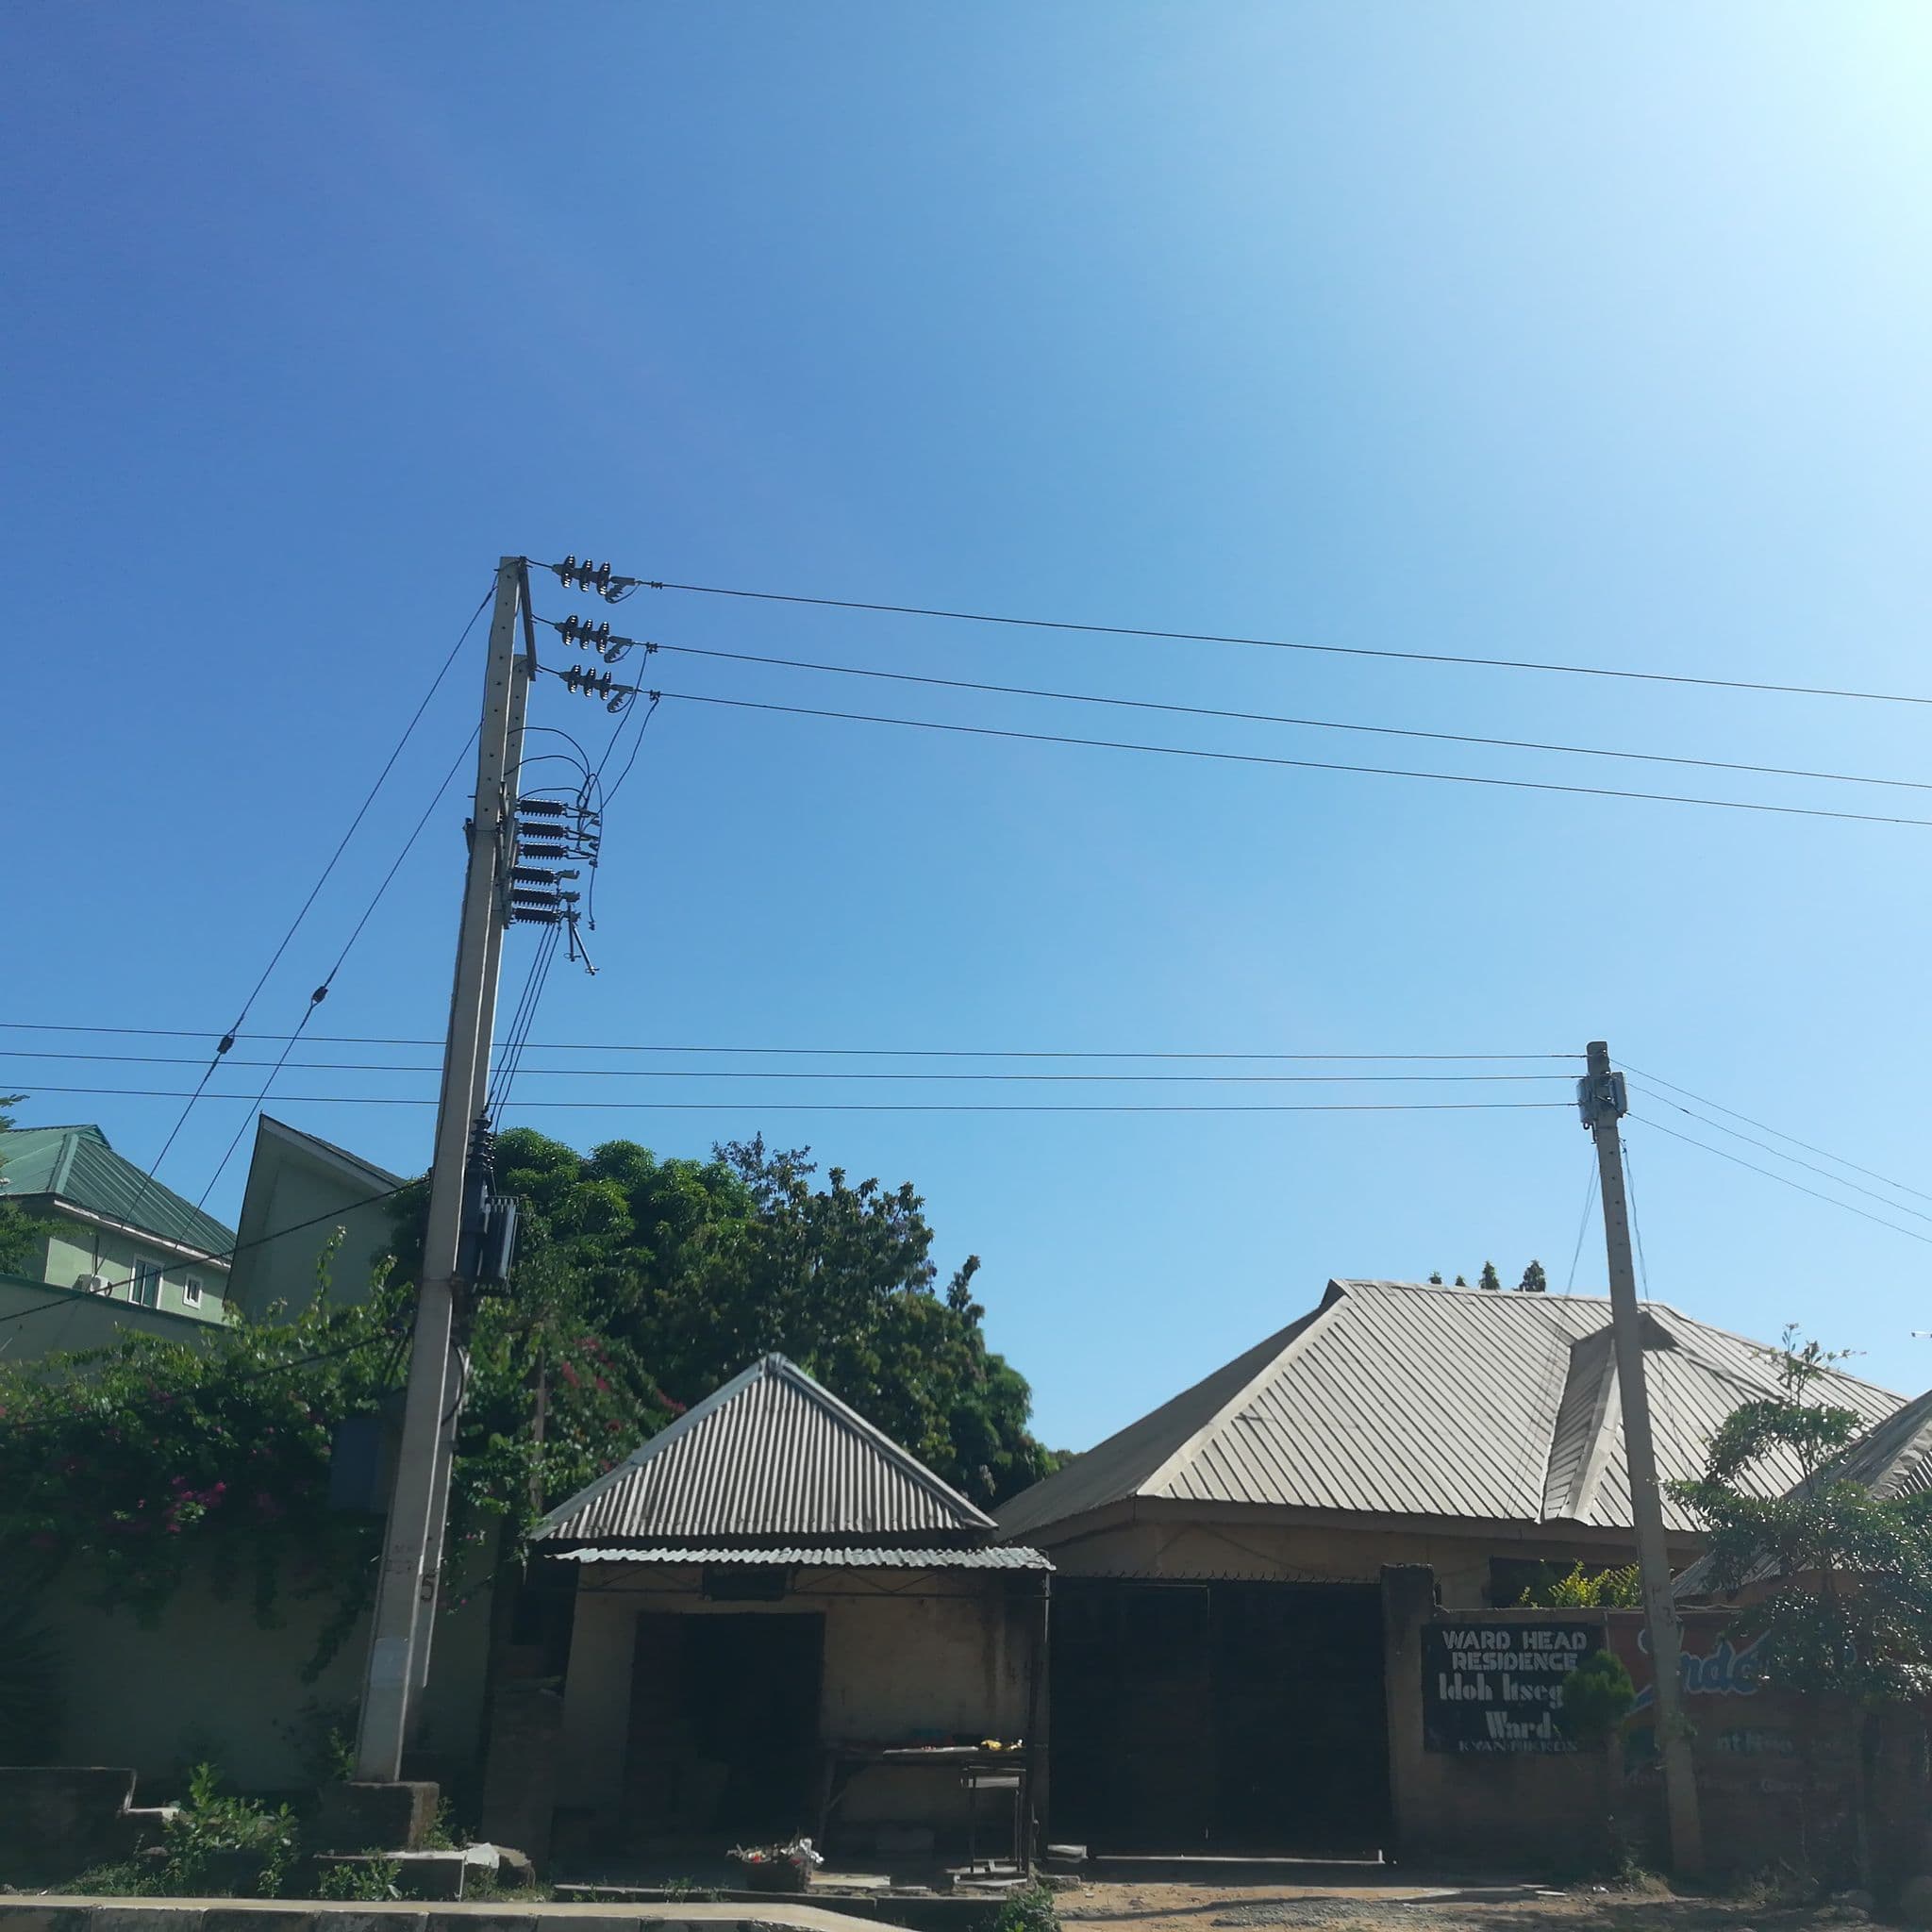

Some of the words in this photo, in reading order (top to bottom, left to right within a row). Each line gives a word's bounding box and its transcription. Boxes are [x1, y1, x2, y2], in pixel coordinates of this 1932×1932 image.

[1441, 1630, 1510, 1650] WARD
[1523, 1631, 1587, 1650] HEAD
[1452, 1652, 1578, 1671] RESIDENCE
[1485, 1710, 1551, 1739] Ward
